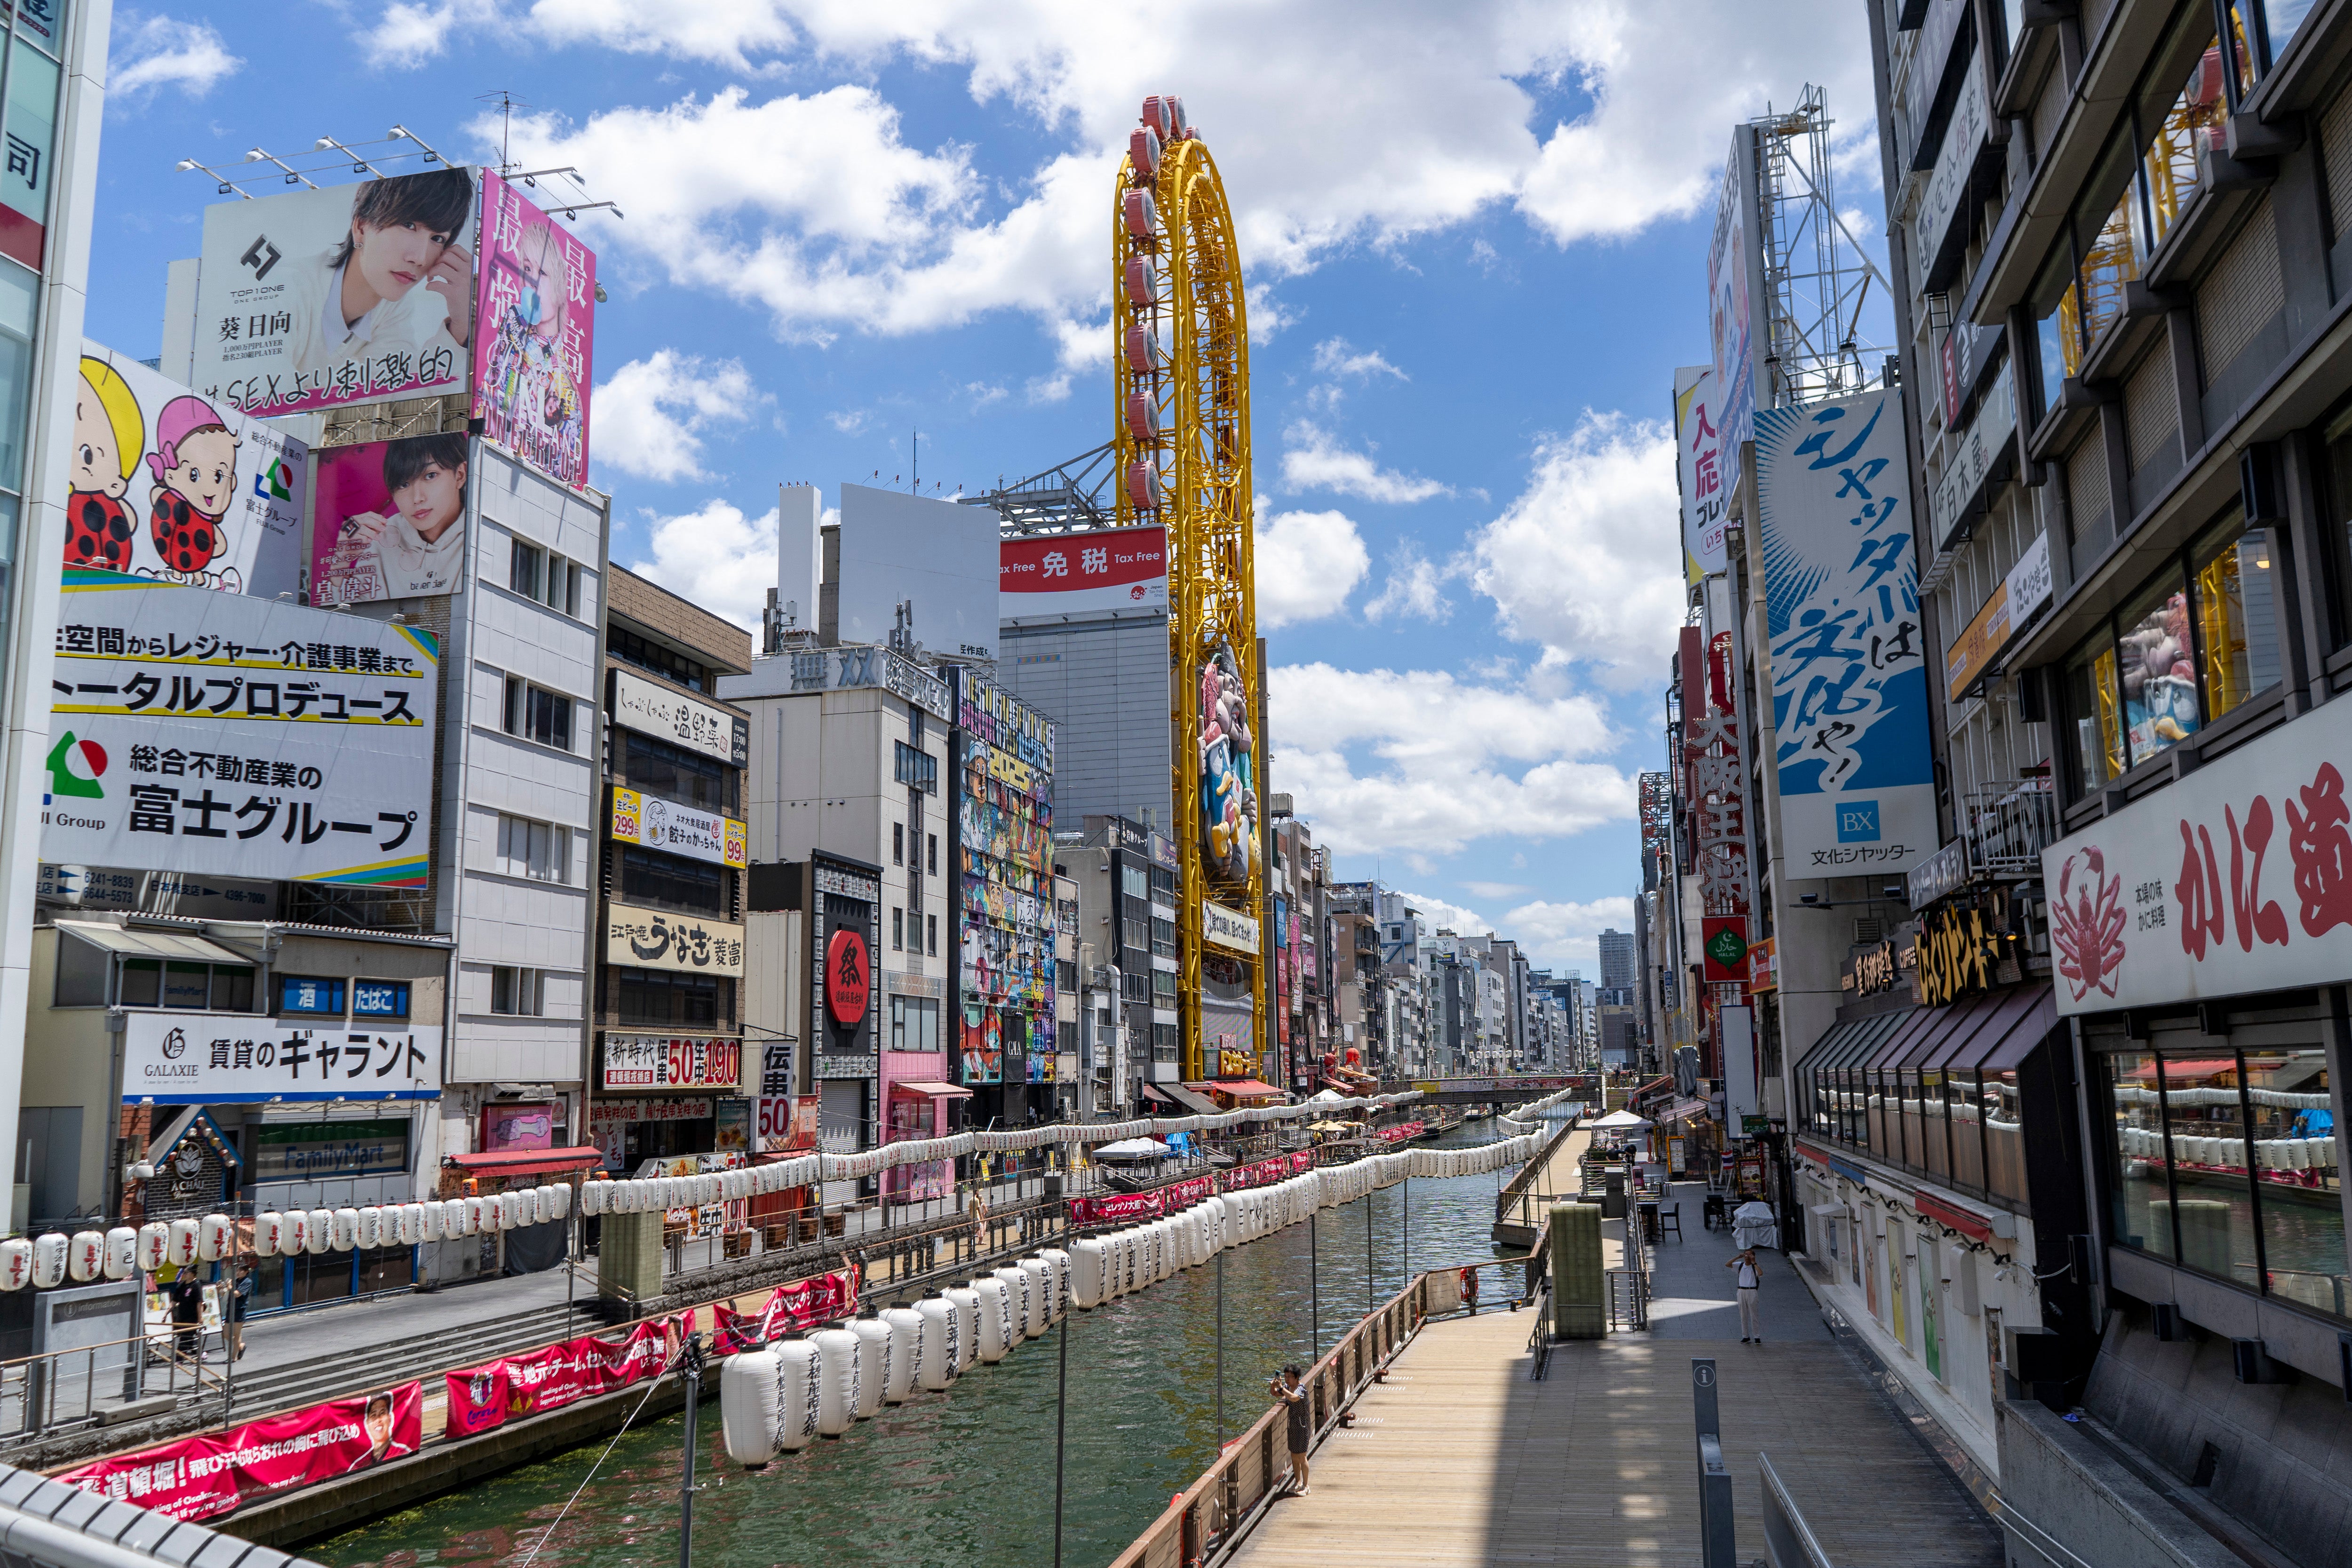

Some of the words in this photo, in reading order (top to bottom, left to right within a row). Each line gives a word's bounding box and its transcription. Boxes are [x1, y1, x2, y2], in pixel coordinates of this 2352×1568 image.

[7, 131, 41, 191] 司
[562, 238, 587, 384] 最高
[218, 317, 241, 343] 葵
[248, 310, 292, 340] 日向
[1943, 350, 1955, 416] 5F
[252, 430, 302, 462] 総合不動産業の
[1937, 490, 1945, 516] 4F
[1947, 433, 1985, 522] 白木屋
[246, 498, 298, 527] 富士グループ
[256, 518, 269, 529] FUJI
[270, 524, 286, 535] Group
[1000, 565, 1009, 574] ax
[1013, 563, 1035, 573] Free
[1114, 553, 1134, 564] Tax
[1136, 551, 1160, 561] Free
[621, 687, 670, 722] しゃぶしゃぶ
[675, 704, 719, 749] 温野菜
[733, 732, 746, 746] 17:00
[129, 744, 323, 790] 総合不動産業の
[990, 745, 1031, 794] 2025
[128, 783, 419, 852] 富士グループ
[617, 799, 638, 813] 生ビール
[1685, 706, 1749, 905] 大阪王将
[56, 813, 106, 831] Group
[676, 813, 711, 831] ネオ大衆居酒屋
[727, 830, 746, 841] ハイボール
[1843, 811, 1875, 832] BX
[668, 825, 722, 852] 餃子のかっちゃん
[42, 866, 54, 880] 店
[85, 871, 134, 889] 6241-8839
[151, 879, 200, 897] 日本橋支店
[224, 889, 266, 904] 4396-7000
[83, 886, 133, 904] 6644-5573
[2135, 878, 2164, 907] 本場の味
[2138, 904, 2166, 932] かに料理
[631, 915, 711, 966] うなぎ
[713, 938, 741, 966] 菱富
[1899, 946, 1916, 969] COFFEE
[298, 983, 316, 1009] 酒
[355, 987, 394, 1012] たばこ
[209, 1029, 426, 1079] 賃貸のギャラント
[611, 1037, 656, 1067] 新時代
[657, 1039, 667, 1084] 伝串
[694, 1039, 705, 1084] 生中
[1008, 1040, 1021, 1056] GALA
[145, 1064, 199, 1076] GALAXIE
[609, 1070, 651, 1083] 道頓堀戎橋店
[763, 1045, 791, 1098] 伝串
[284, 1141, 384, 1170] FamilyMart
[78, 1298, 122, 1312] information
